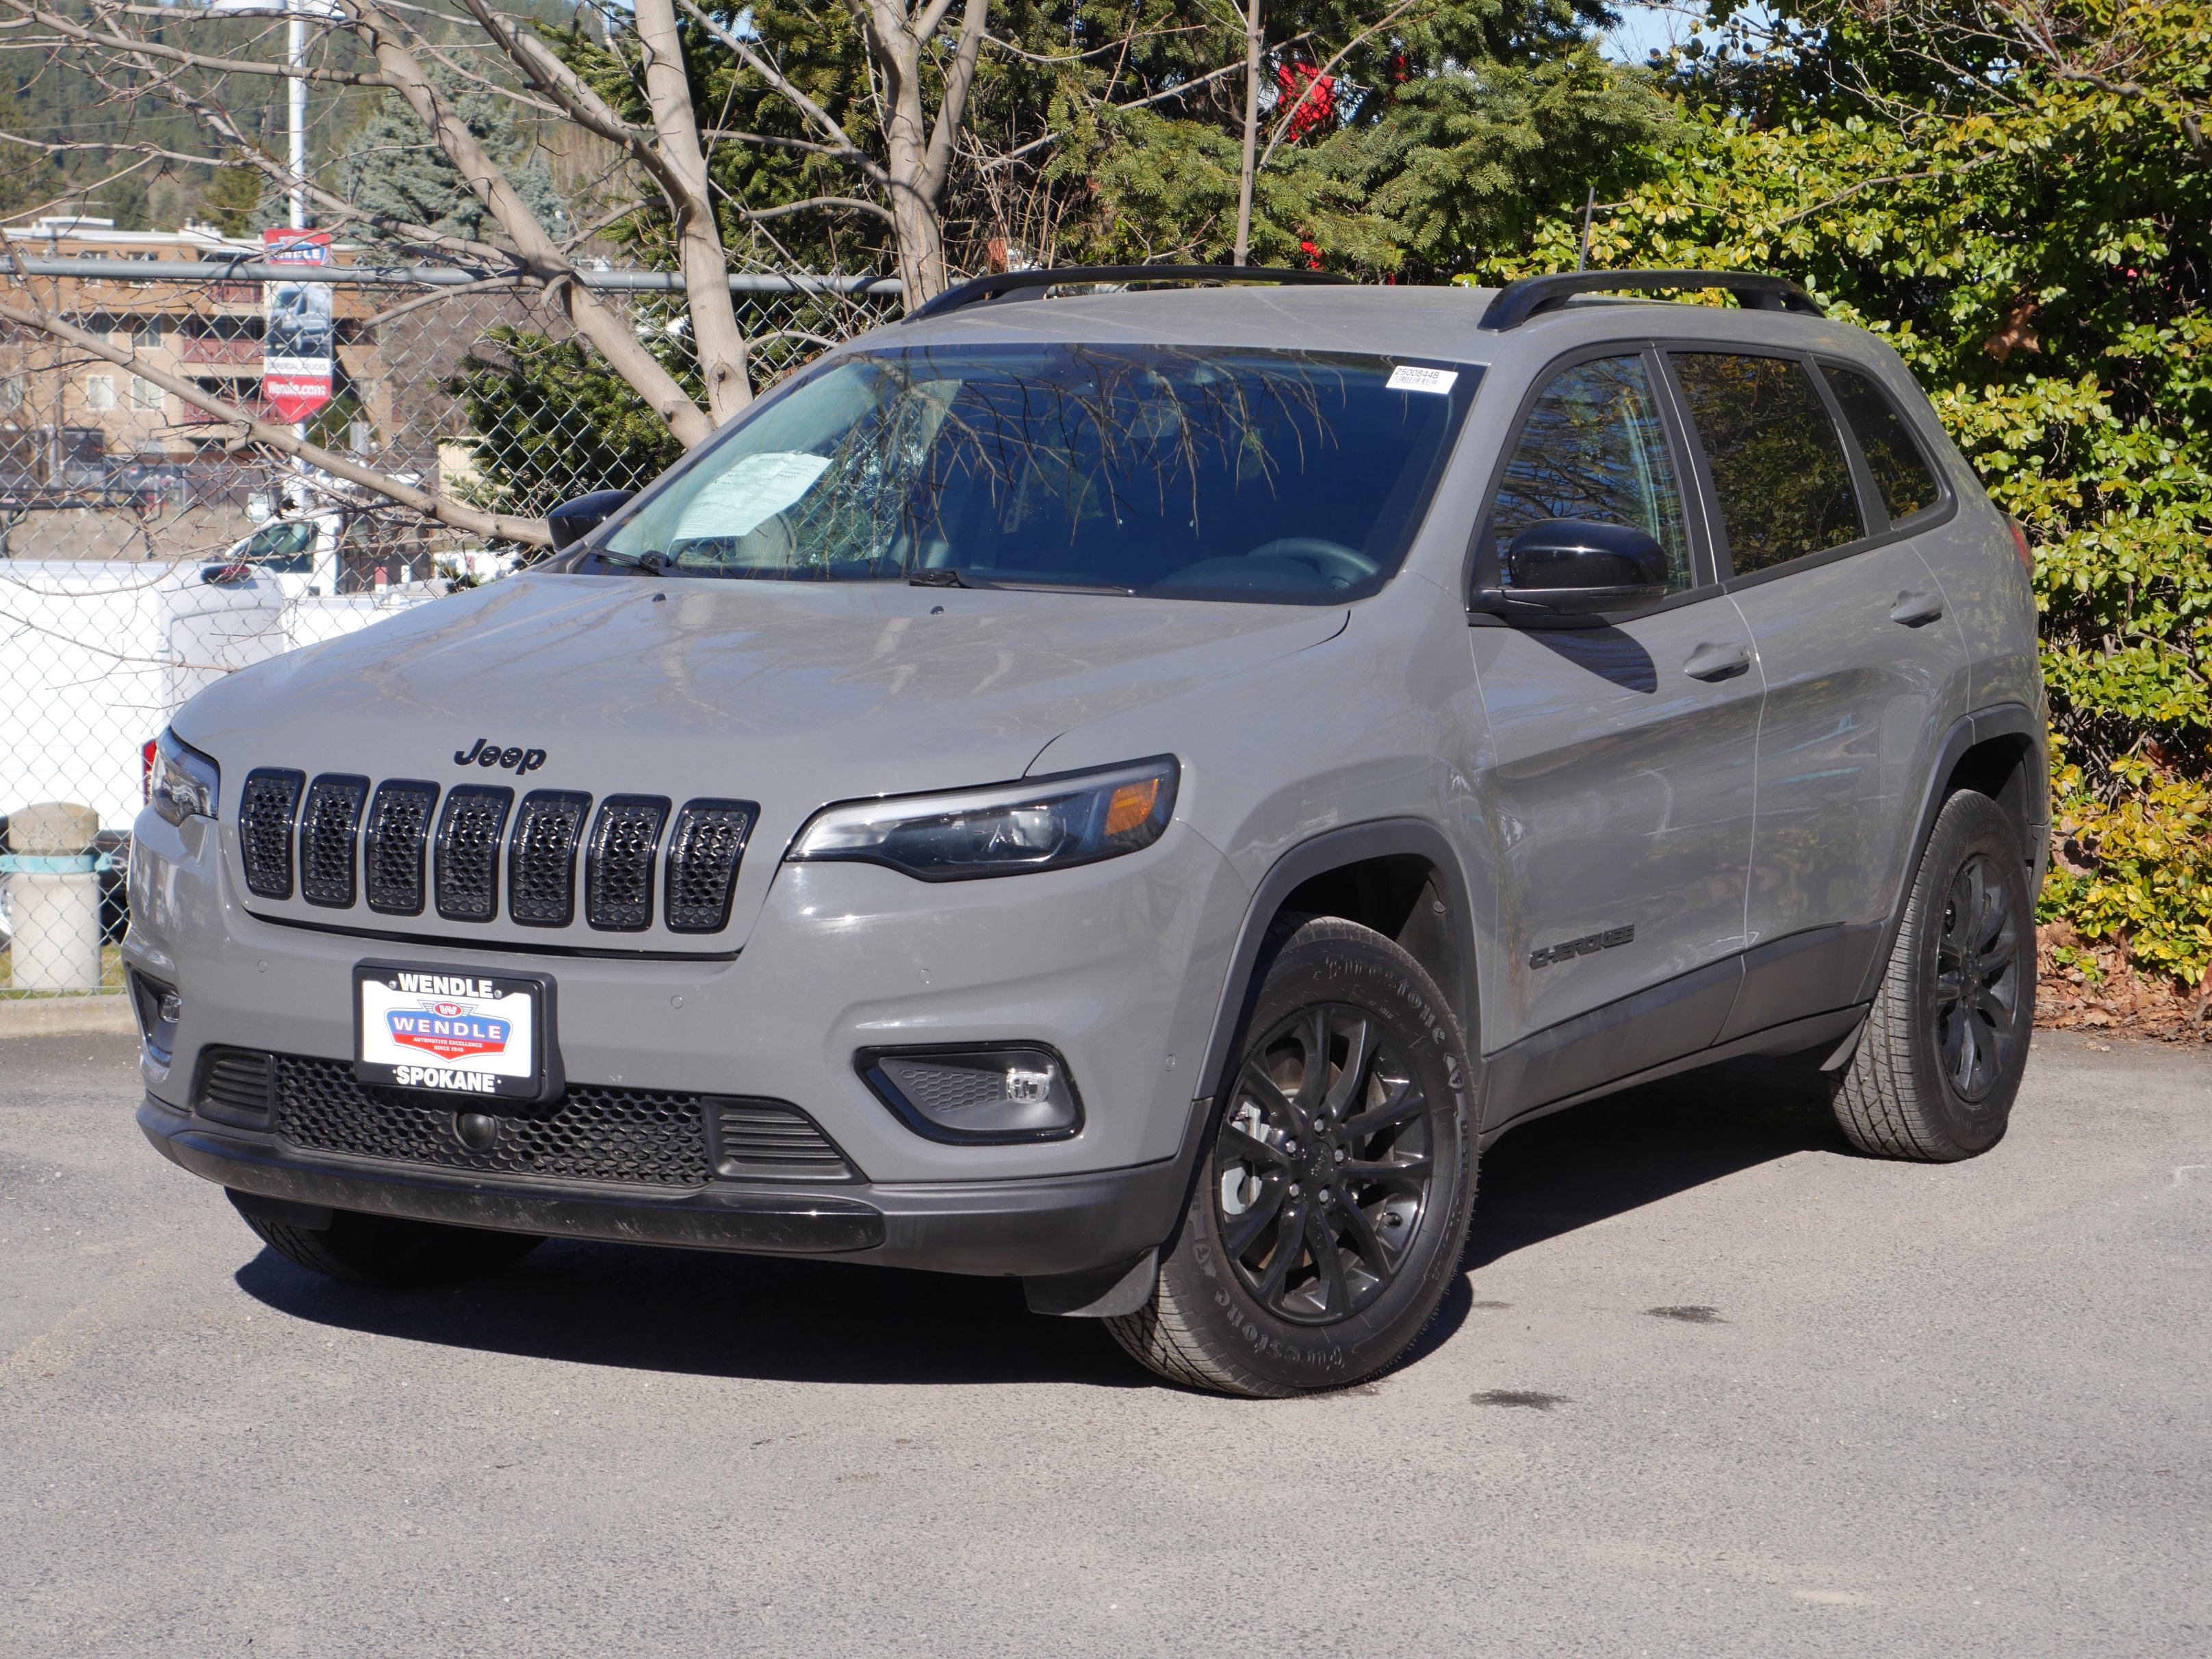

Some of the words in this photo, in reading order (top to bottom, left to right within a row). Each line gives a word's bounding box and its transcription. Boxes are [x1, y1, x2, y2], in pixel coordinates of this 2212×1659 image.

[270, 248, 321, 259] NDLE
[454, 738, 547, 775] Jeep
[398, 973, 494, 999] WENDLE
[393, 1016, 502, 1040] WENDLE
[413, 1036, 448, 1045] AUTOMOTIVE
[448, 1040, 483, 1049] EXCELLENCE
[396, 1065, 495, 1094] SPOKANE
